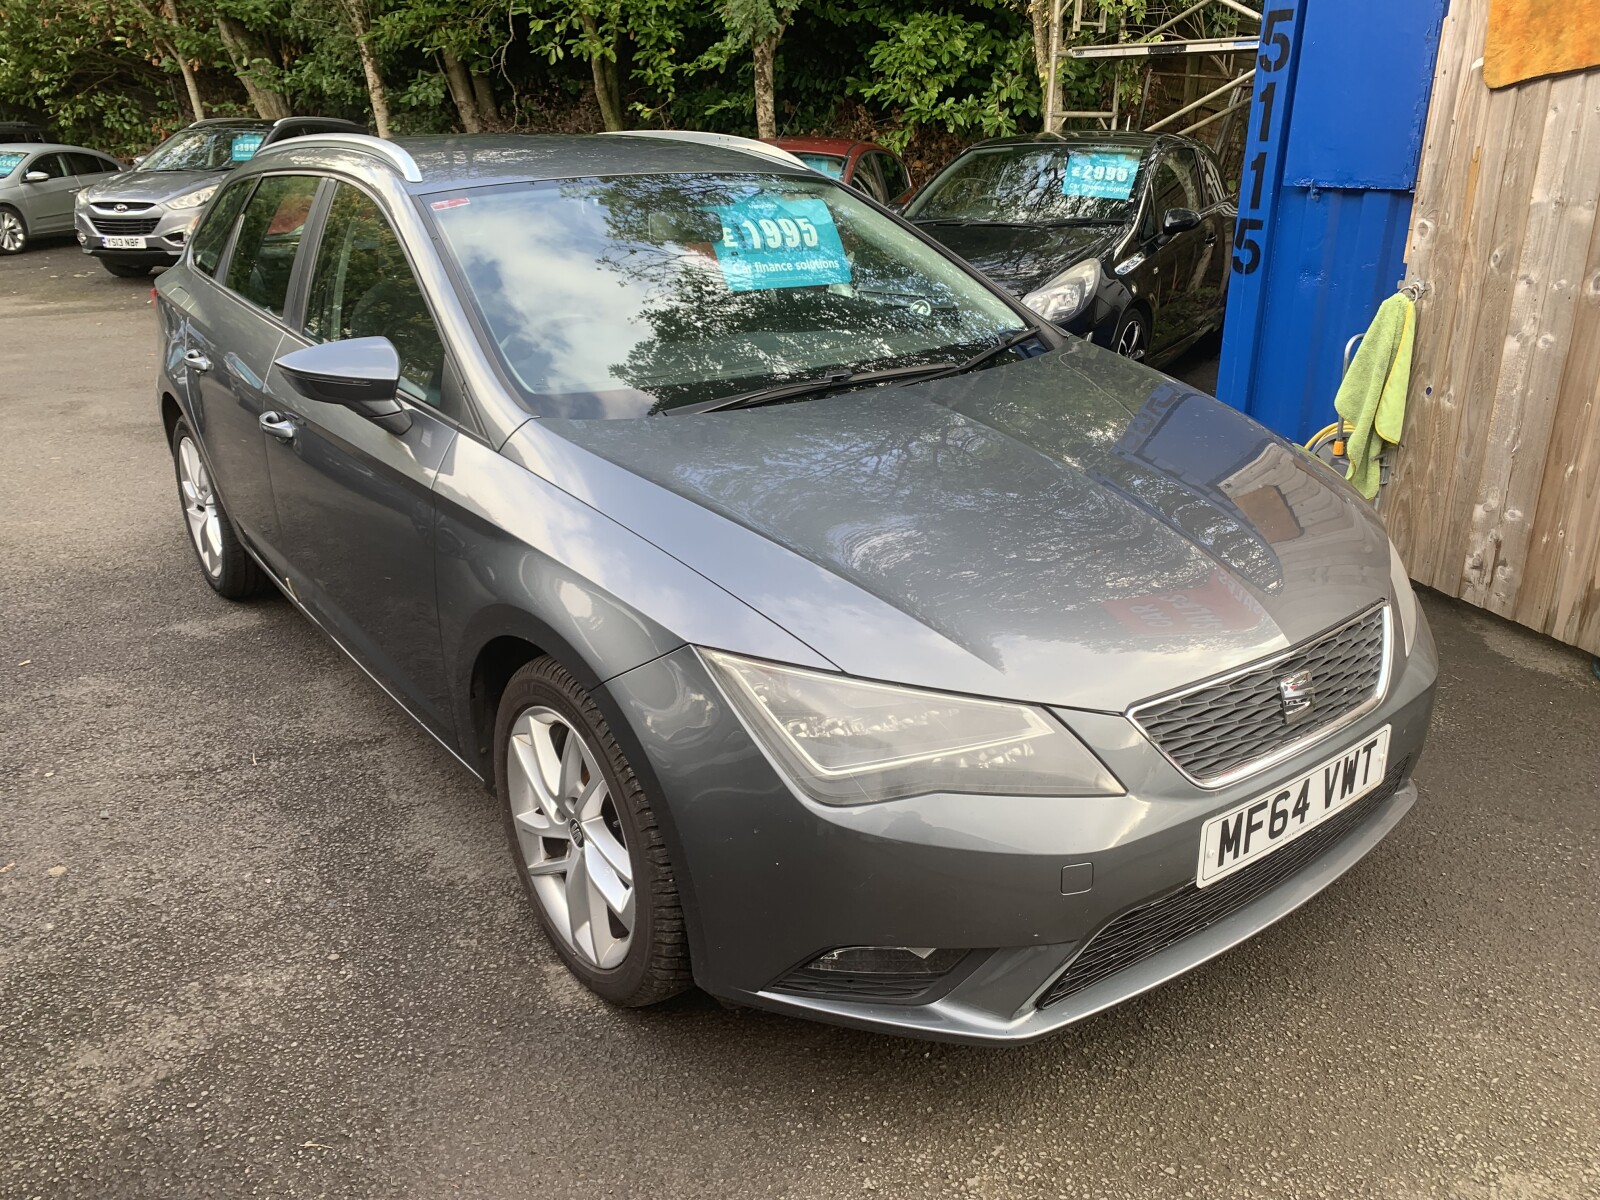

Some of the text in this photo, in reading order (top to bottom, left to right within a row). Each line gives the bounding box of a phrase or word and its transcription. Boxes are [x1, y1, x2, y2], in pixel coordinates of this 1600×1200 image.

[1232, 8, 1294, 275] 5115
[732, 259, 840, 274] Car finance solutions
[1217, 738, 1378, 868] MF64 VWT
